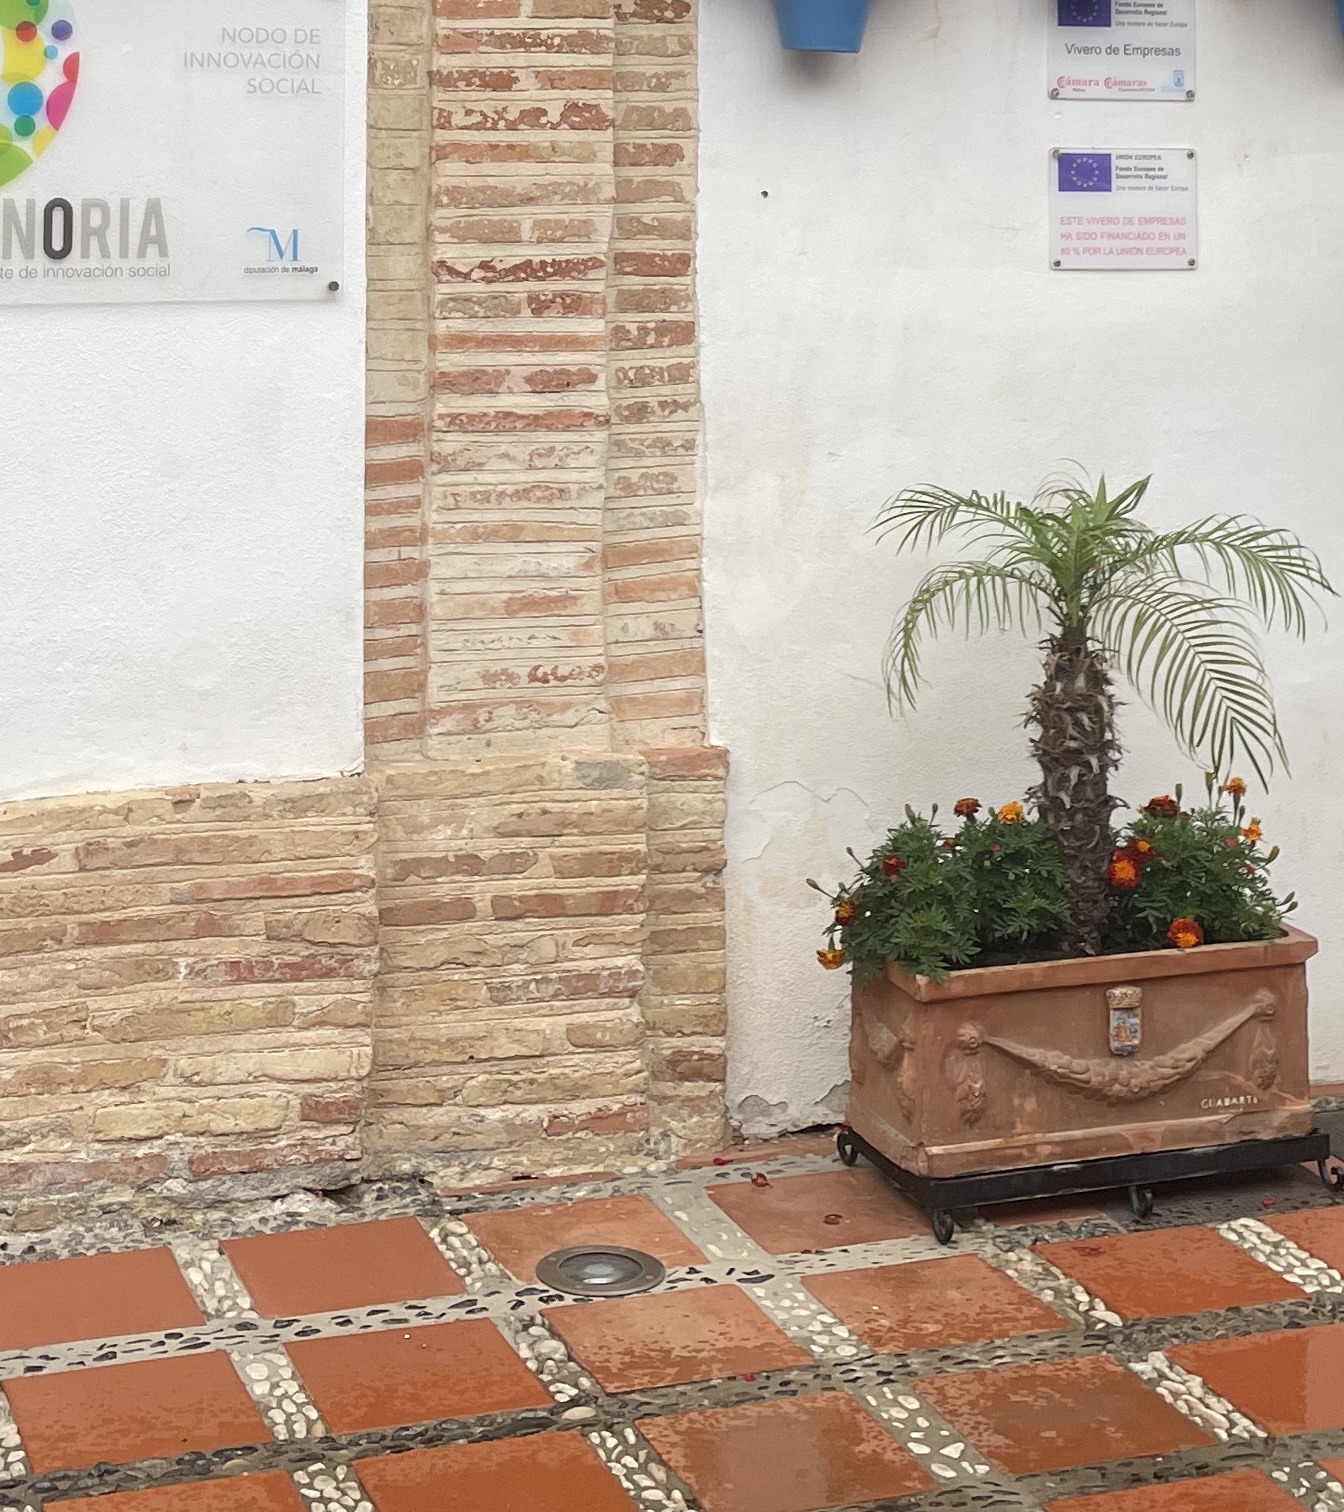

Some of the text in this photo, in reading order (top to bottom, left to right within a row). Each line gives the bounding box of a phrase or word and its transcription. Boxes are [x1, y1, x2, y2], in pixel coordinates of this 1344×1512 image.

[221, 27, 321, 44] NODO DE
[1064, 43, 1181, 58] Vivero de Empresas
[184, 50, 320, 69] INNOVACIÓN
[246, 78, 322, 94] SOCIAL
[1060, 216, 1187, 225] ESTE VIVERO DE EMPRESAS
[2, 197, 170, 260] NORIA
[1060, 232, 1073, 241] HA
[1075, 232, 1098, 241] SIDO
[1100, 232, 1155, 241] FINANCIADO
[1158, 232, 1171, 241] EN
[1082, 247, 1101, 256] POR
[1103, 247, 1114, 256] LA
[1146, 247, 1187, 256] EUROPEA
[19, 265, 38, 279] de
[43, 264, 123, 278] innovación
[128, 263, 171, 278] social
[281, 265, 290, 273] de
